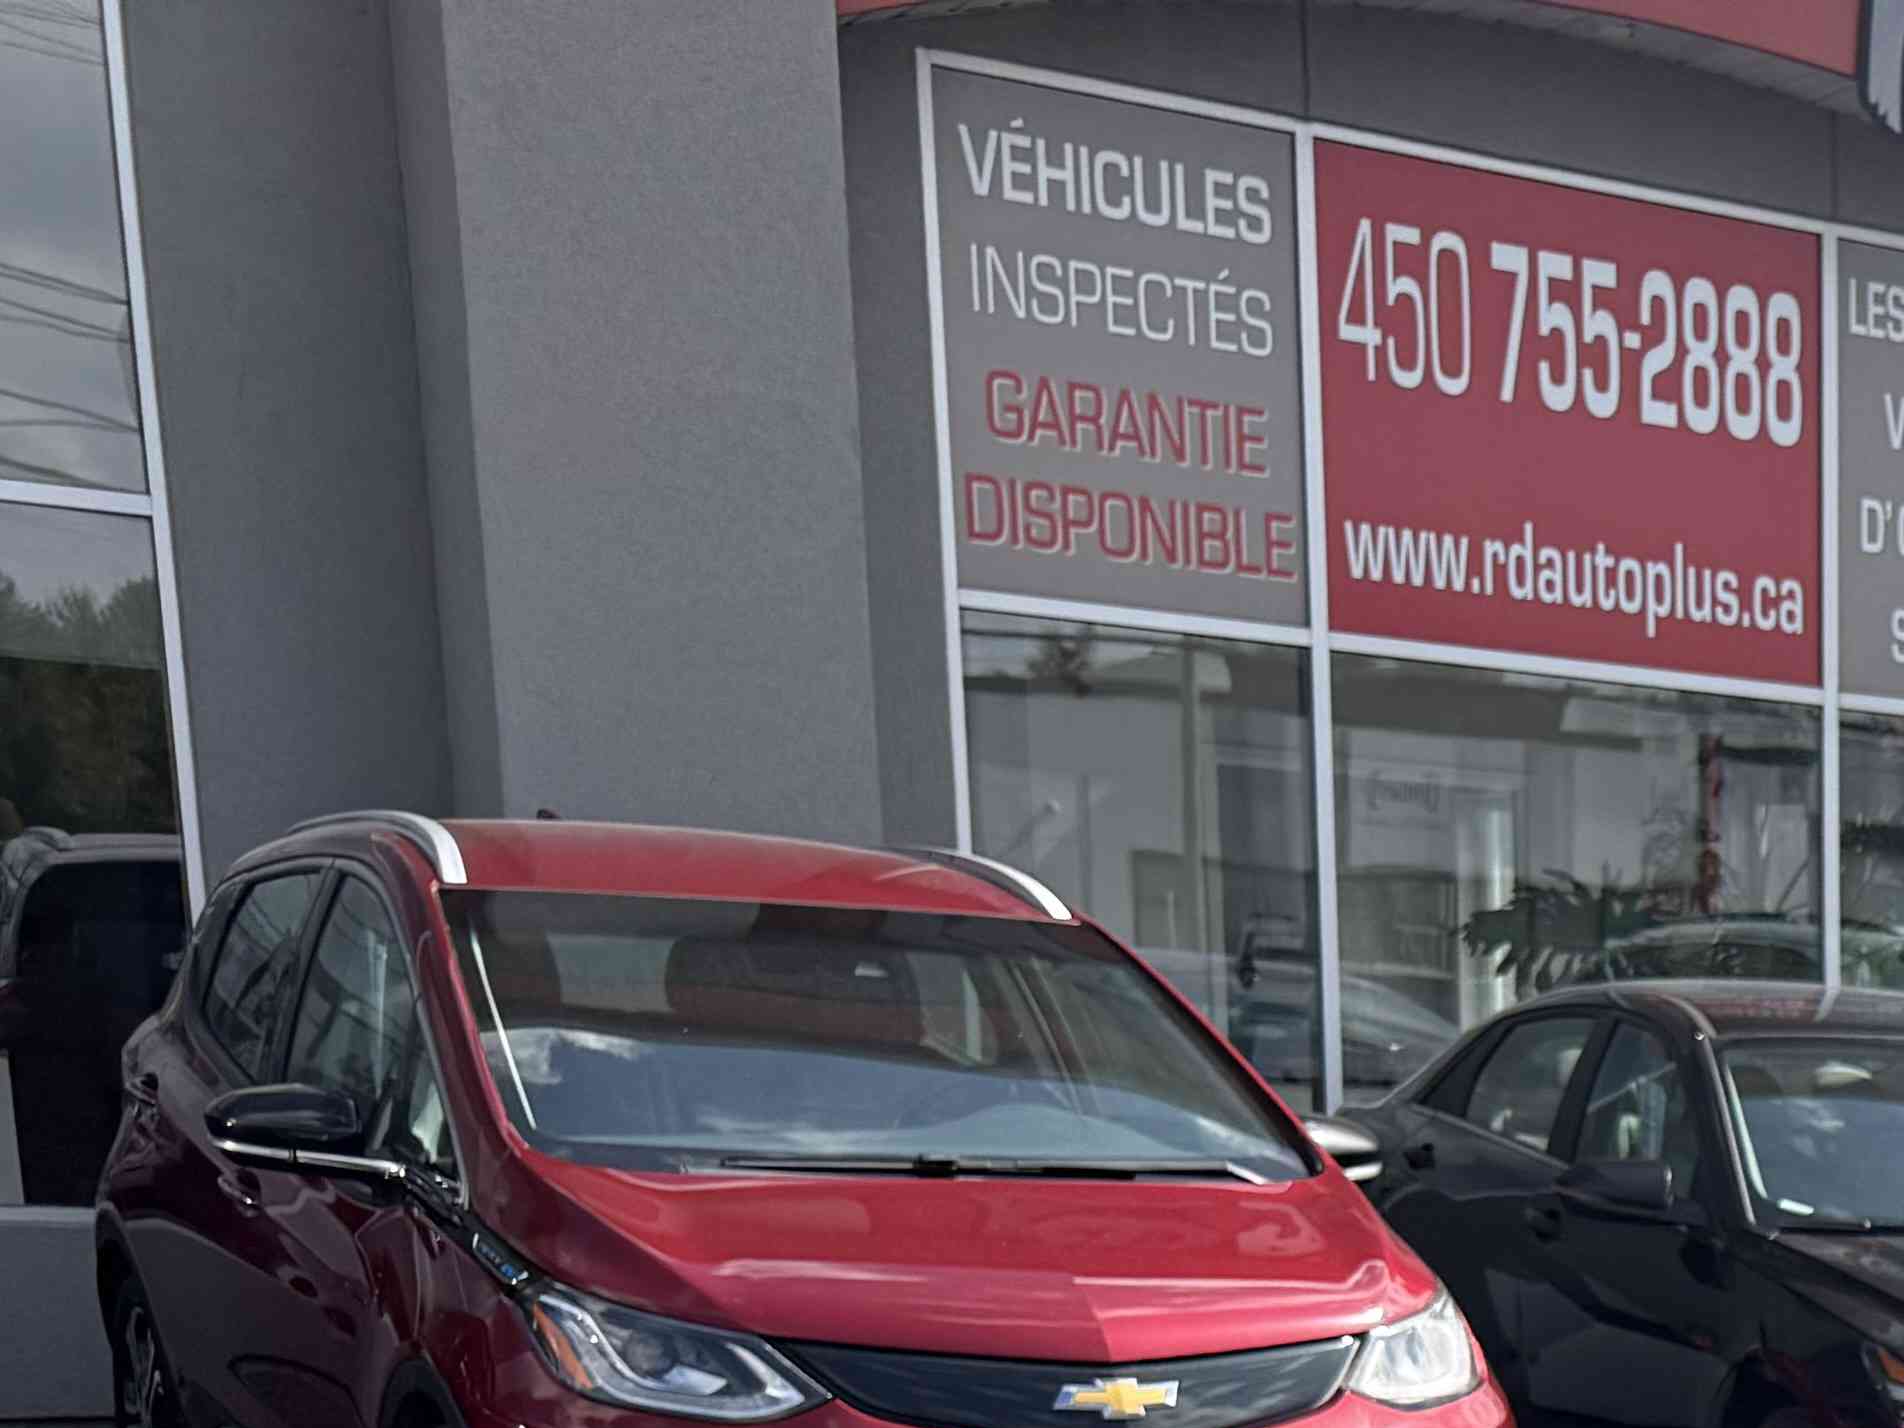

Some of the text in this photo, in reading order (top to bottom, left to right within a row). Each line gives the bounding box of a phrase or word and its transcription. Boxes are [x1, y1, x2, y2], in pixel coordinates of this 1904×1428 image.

[957, 117, 1273, 246] VÉHICULES
[970, 242, 1273, 358] INSPECTÉS
[1337, 216, 1803, 448] 450 755-2888
[984, 369, 1271, 478] GARANTIE
[964, 471, 1298, 583] DISPONIBLE
[1343, 519, 1805, 639] www.rdautoplus.ca
